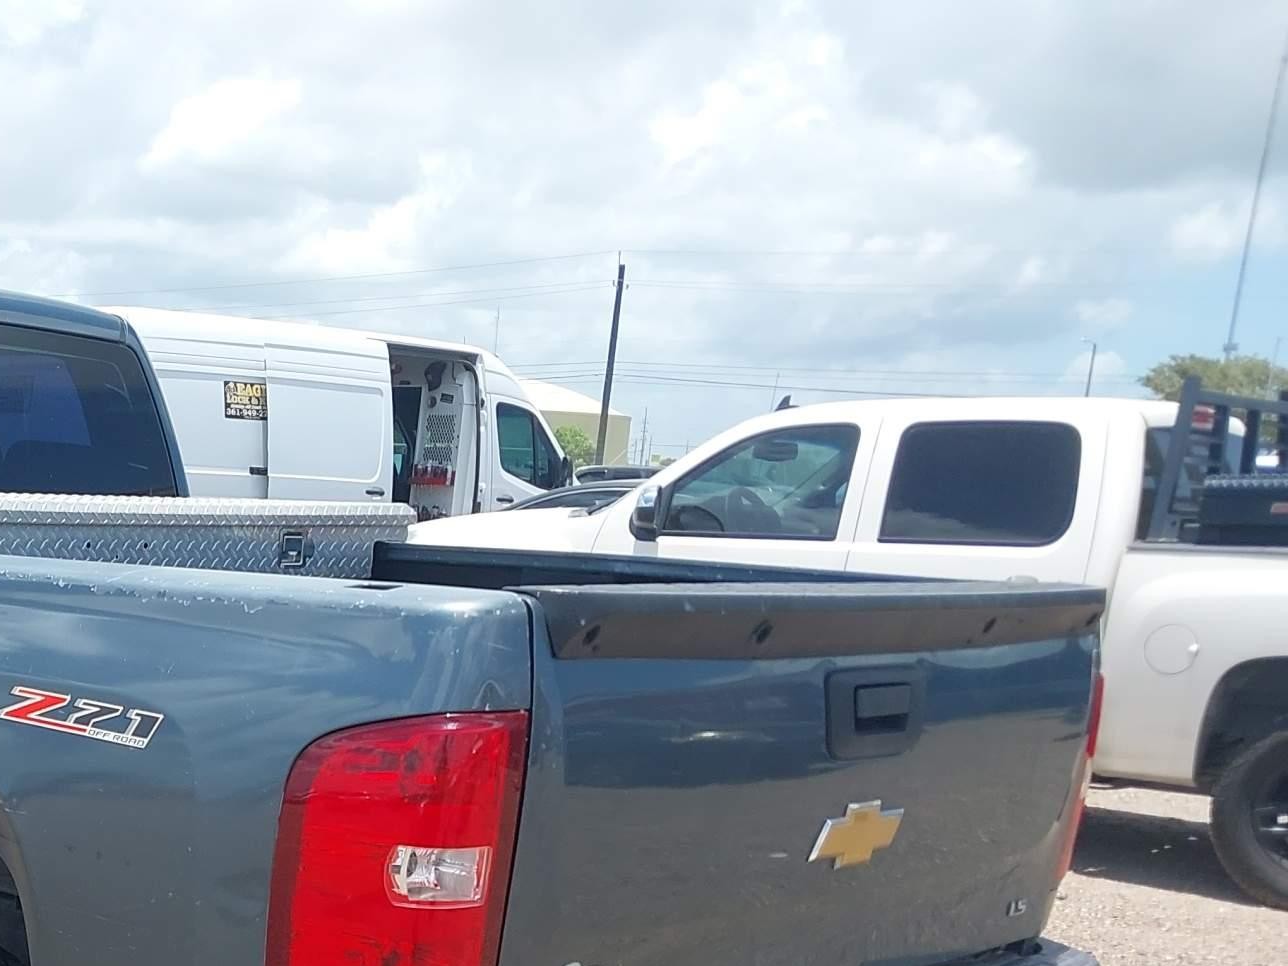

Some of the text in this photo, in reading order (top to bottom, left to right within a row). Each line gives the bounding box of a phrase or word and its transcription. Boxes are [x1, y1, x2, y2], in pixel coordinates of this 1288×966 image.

[88, 729, 145, 747] OFF ROAD
[1006, 899, 1027, 916] LS
